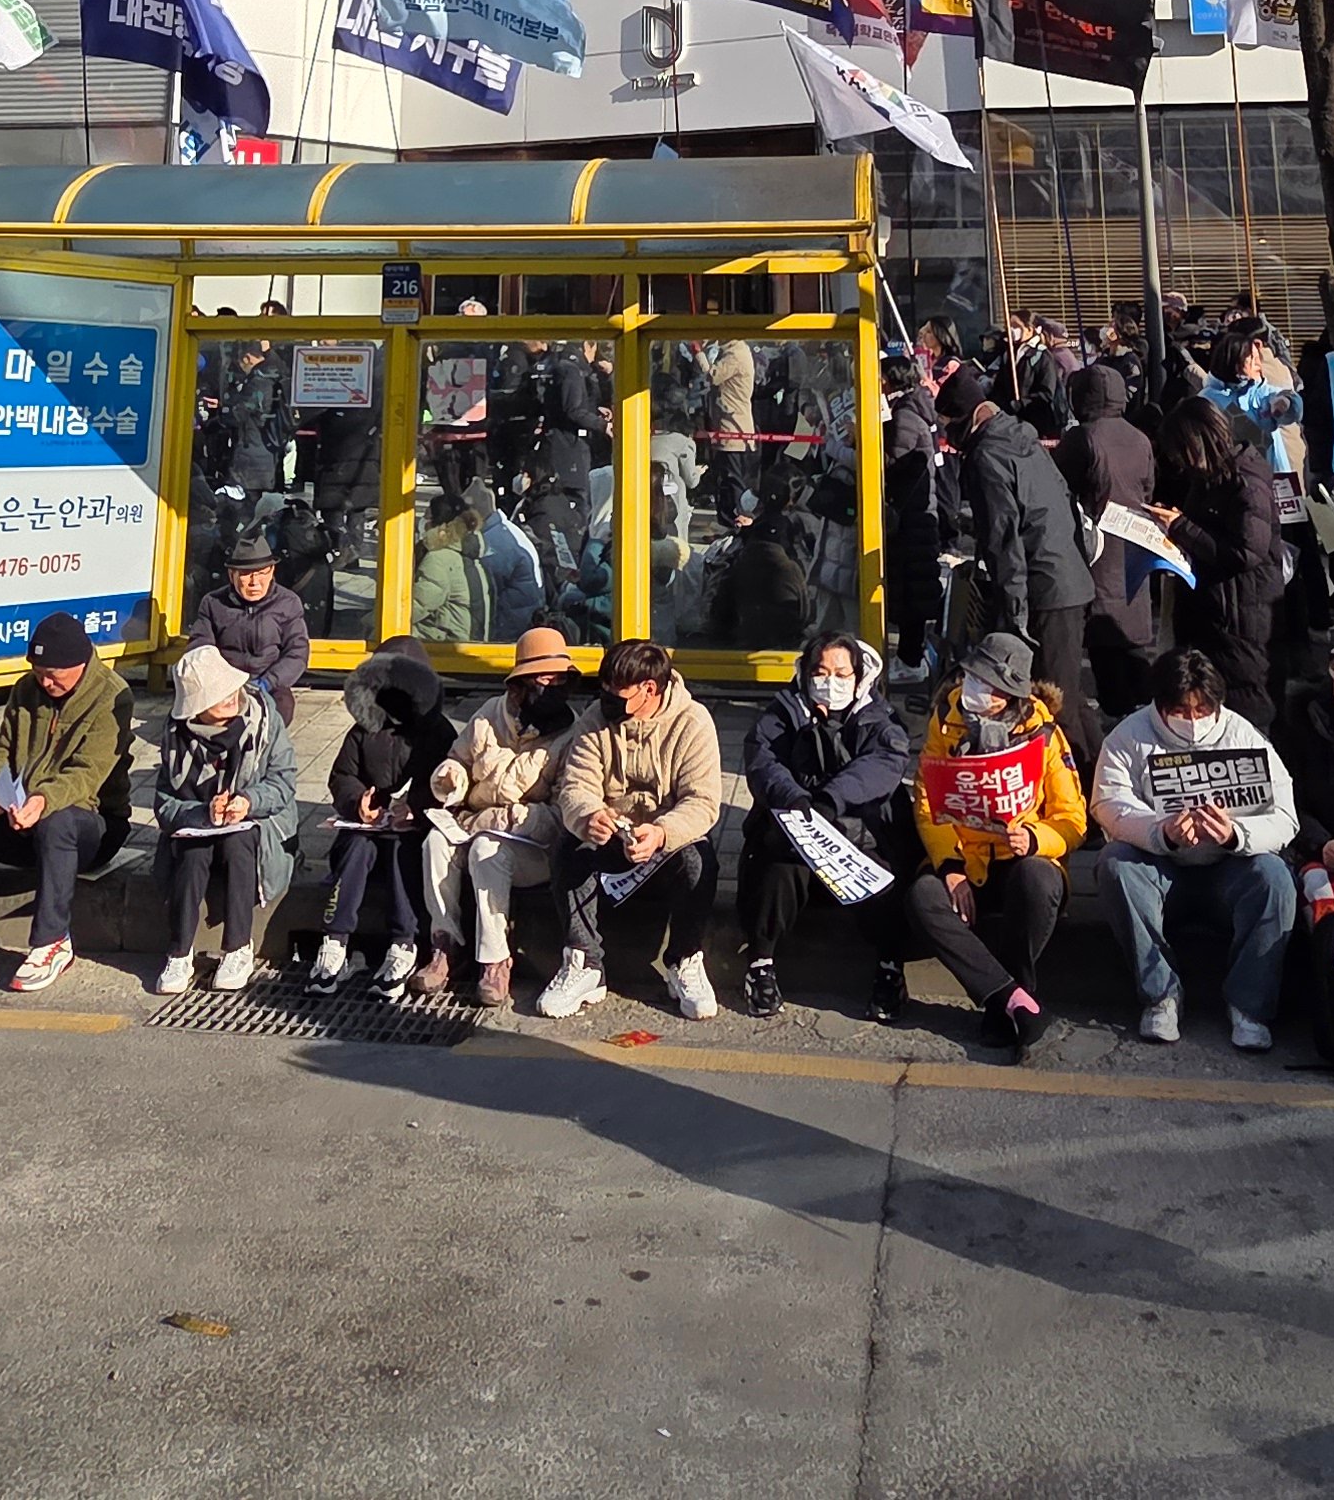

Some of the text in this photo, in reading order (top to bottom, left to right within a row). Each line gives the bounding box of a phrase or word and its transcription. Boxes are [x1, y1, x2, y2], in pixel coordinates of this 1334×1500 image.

[493, 11, 560, 43] 대전본부
[392, 279, 419, 296] 216
[84, 610, 118, 635] 출구
[955, 762, 1025, 795] 윤석열
[1152, 756, 1268, 793] 국민의힘
[944, 781, 1036, 818] 즉각 파면
[1211, 785, 1269, 810] 해체!
